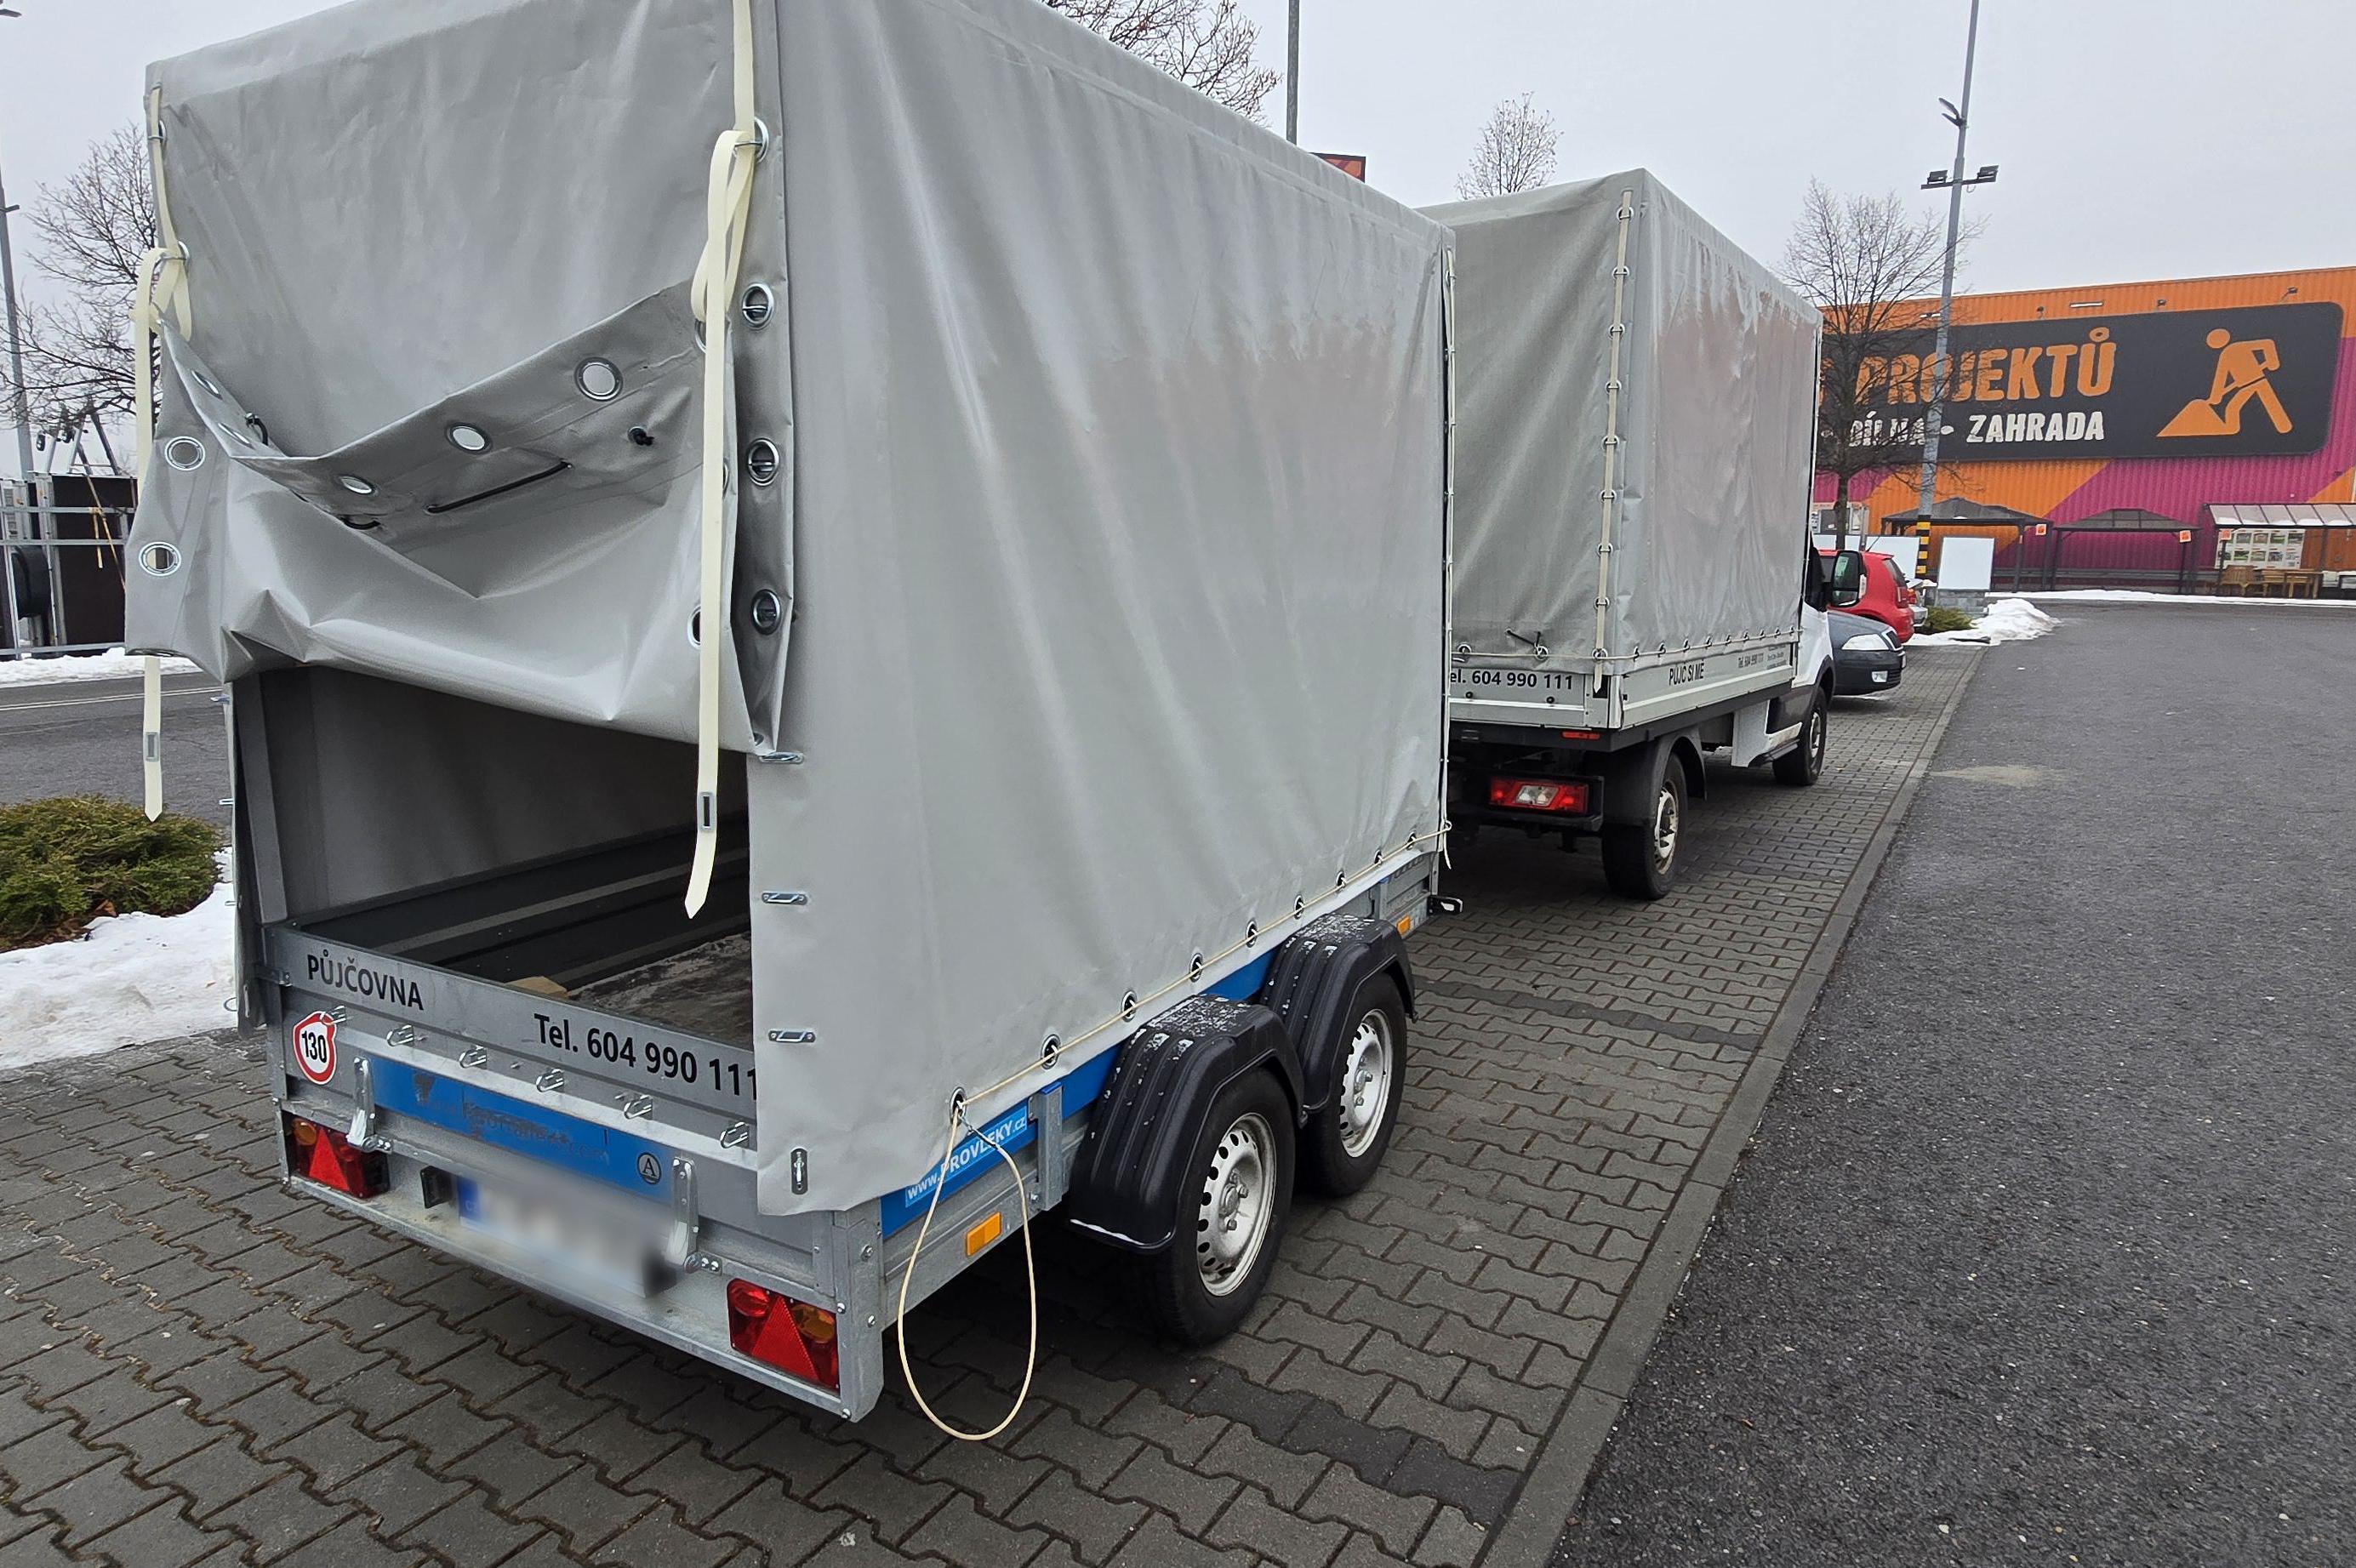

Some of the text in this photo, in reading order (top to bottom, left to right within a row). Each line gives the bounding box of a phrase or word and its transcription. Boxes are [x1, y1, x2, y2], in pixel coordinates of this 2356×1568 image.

[1854, 327, 2116, 405] PROJEKTŮ
[1966, 411, 2104, 442] ZAHRADA
[1450, 669, 1572, 690] el. 604 990 111
[307, 949, 424, 1010] PŮJČOVNA
[302, 1030, 328, 1063] 130
[534, 1013, 756, 1100] Tel. 604 990 111
